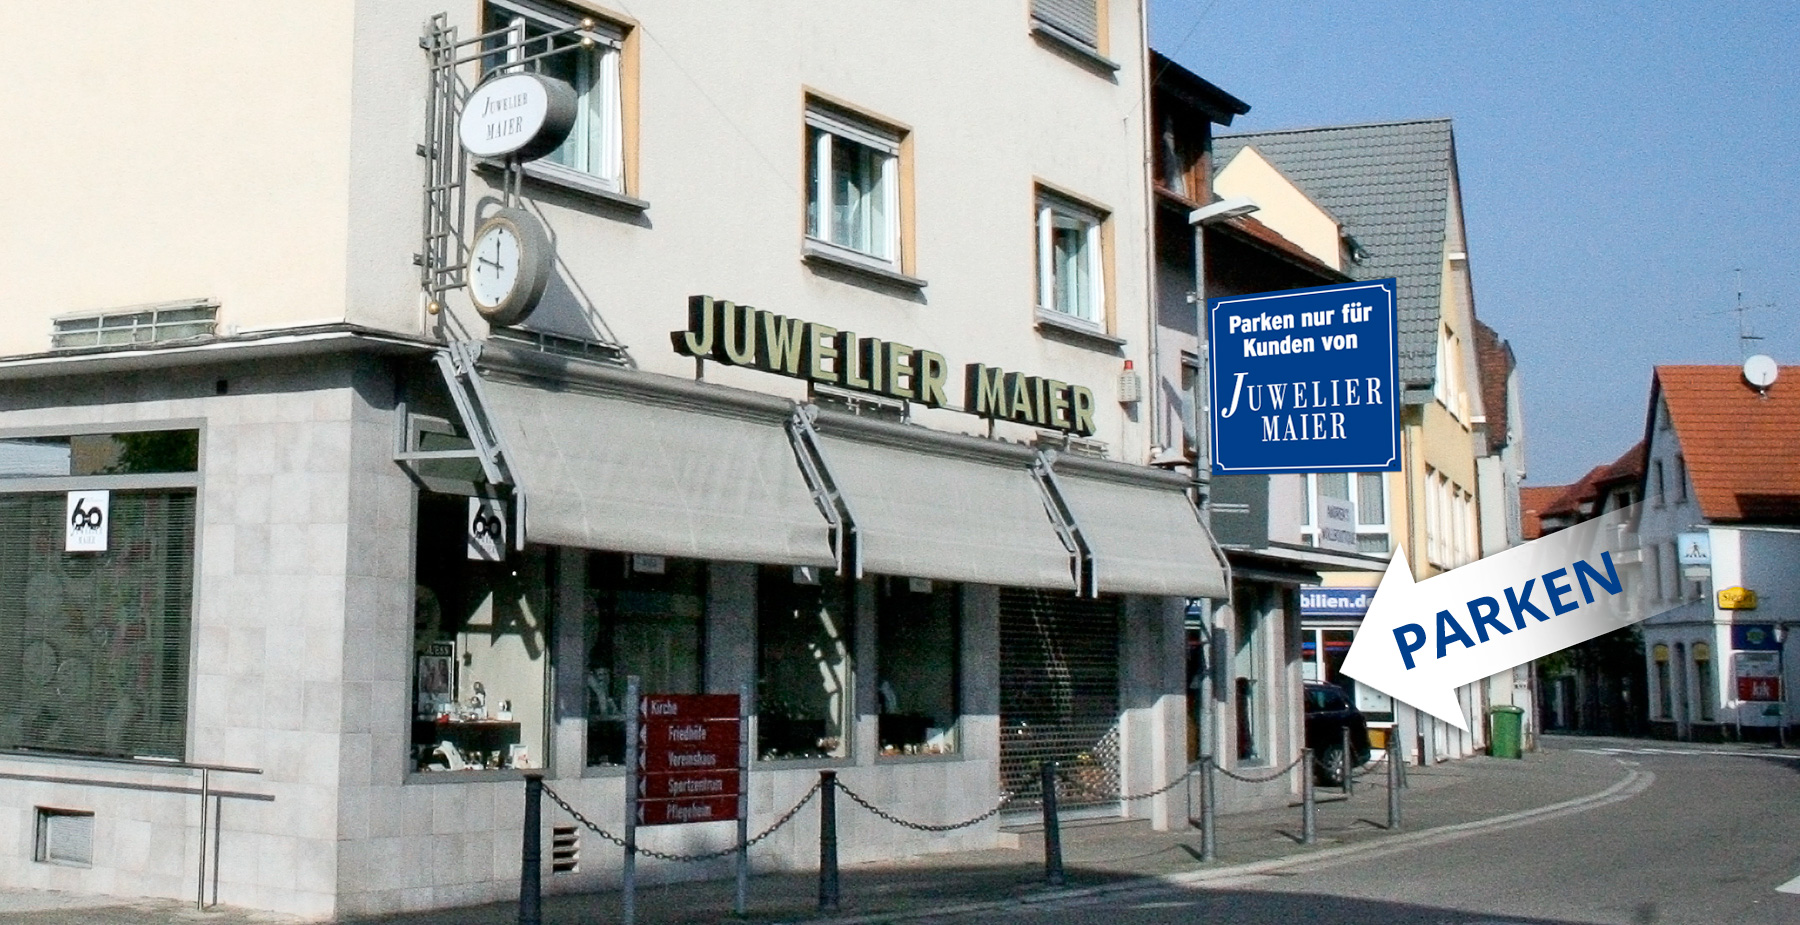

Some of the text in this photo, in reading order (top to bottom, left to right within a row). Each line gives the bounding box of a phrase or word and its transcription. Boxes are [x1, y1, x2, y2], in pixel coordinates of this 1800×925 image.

[481, 92, 528, 118] JUWELIER
[486, 116, 523, 141] MAIER
[1229, 302, 1373, 334] Parken nur für
[1243, 333, 1358, 358] Kunden von
[680, 295, 1097, 436] JUWELIER MAIER
[1221, 372, 1383, 419] JUWELIER
[1261, 412, 1347, 442] MAIER
[72, 498, 102, 530] 60
[650, 700, 678, 715] Kirche
[668, 778, 723, 796] Sportzentrum
[666, 802, 712, 821] Pflegeheim
